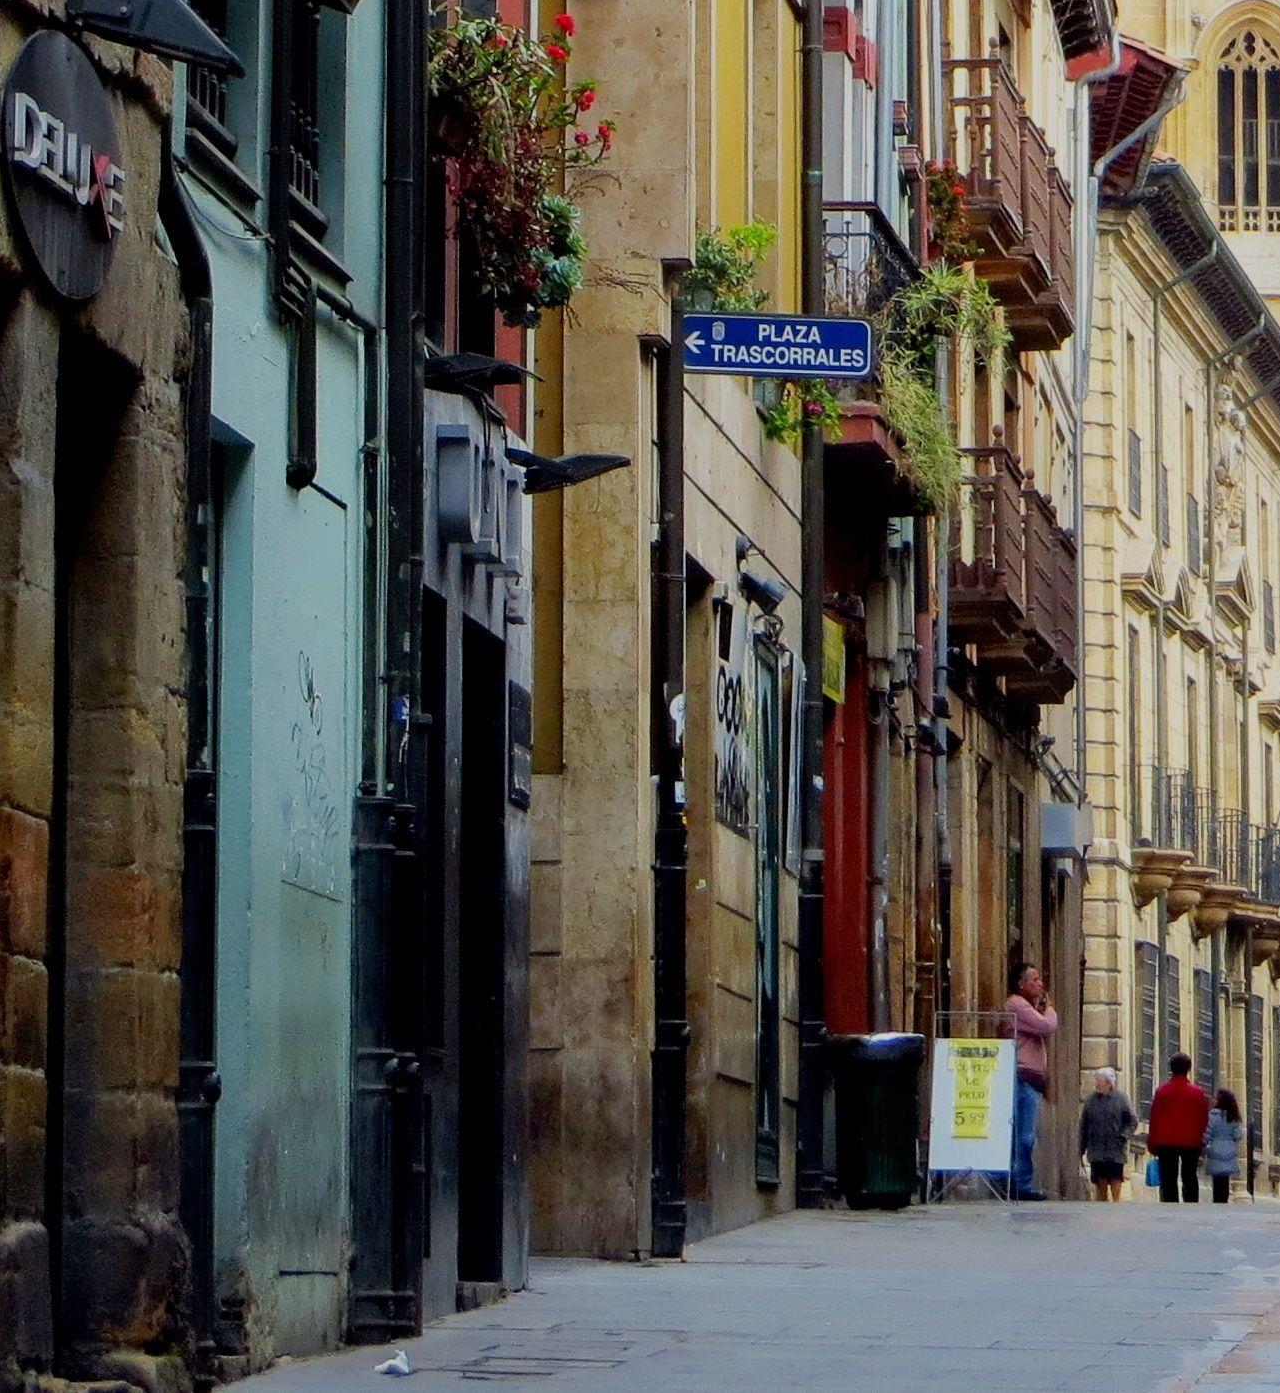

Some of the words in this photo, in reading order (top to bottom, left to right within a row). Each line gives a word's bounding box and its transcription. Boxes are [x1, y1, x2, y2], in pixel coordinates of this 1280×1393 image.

[14, 92, 126, 240] DELUXE
[758, 323, 821, 344] PLAZA
[710, 344, 865, 368] TRASCORRALES
